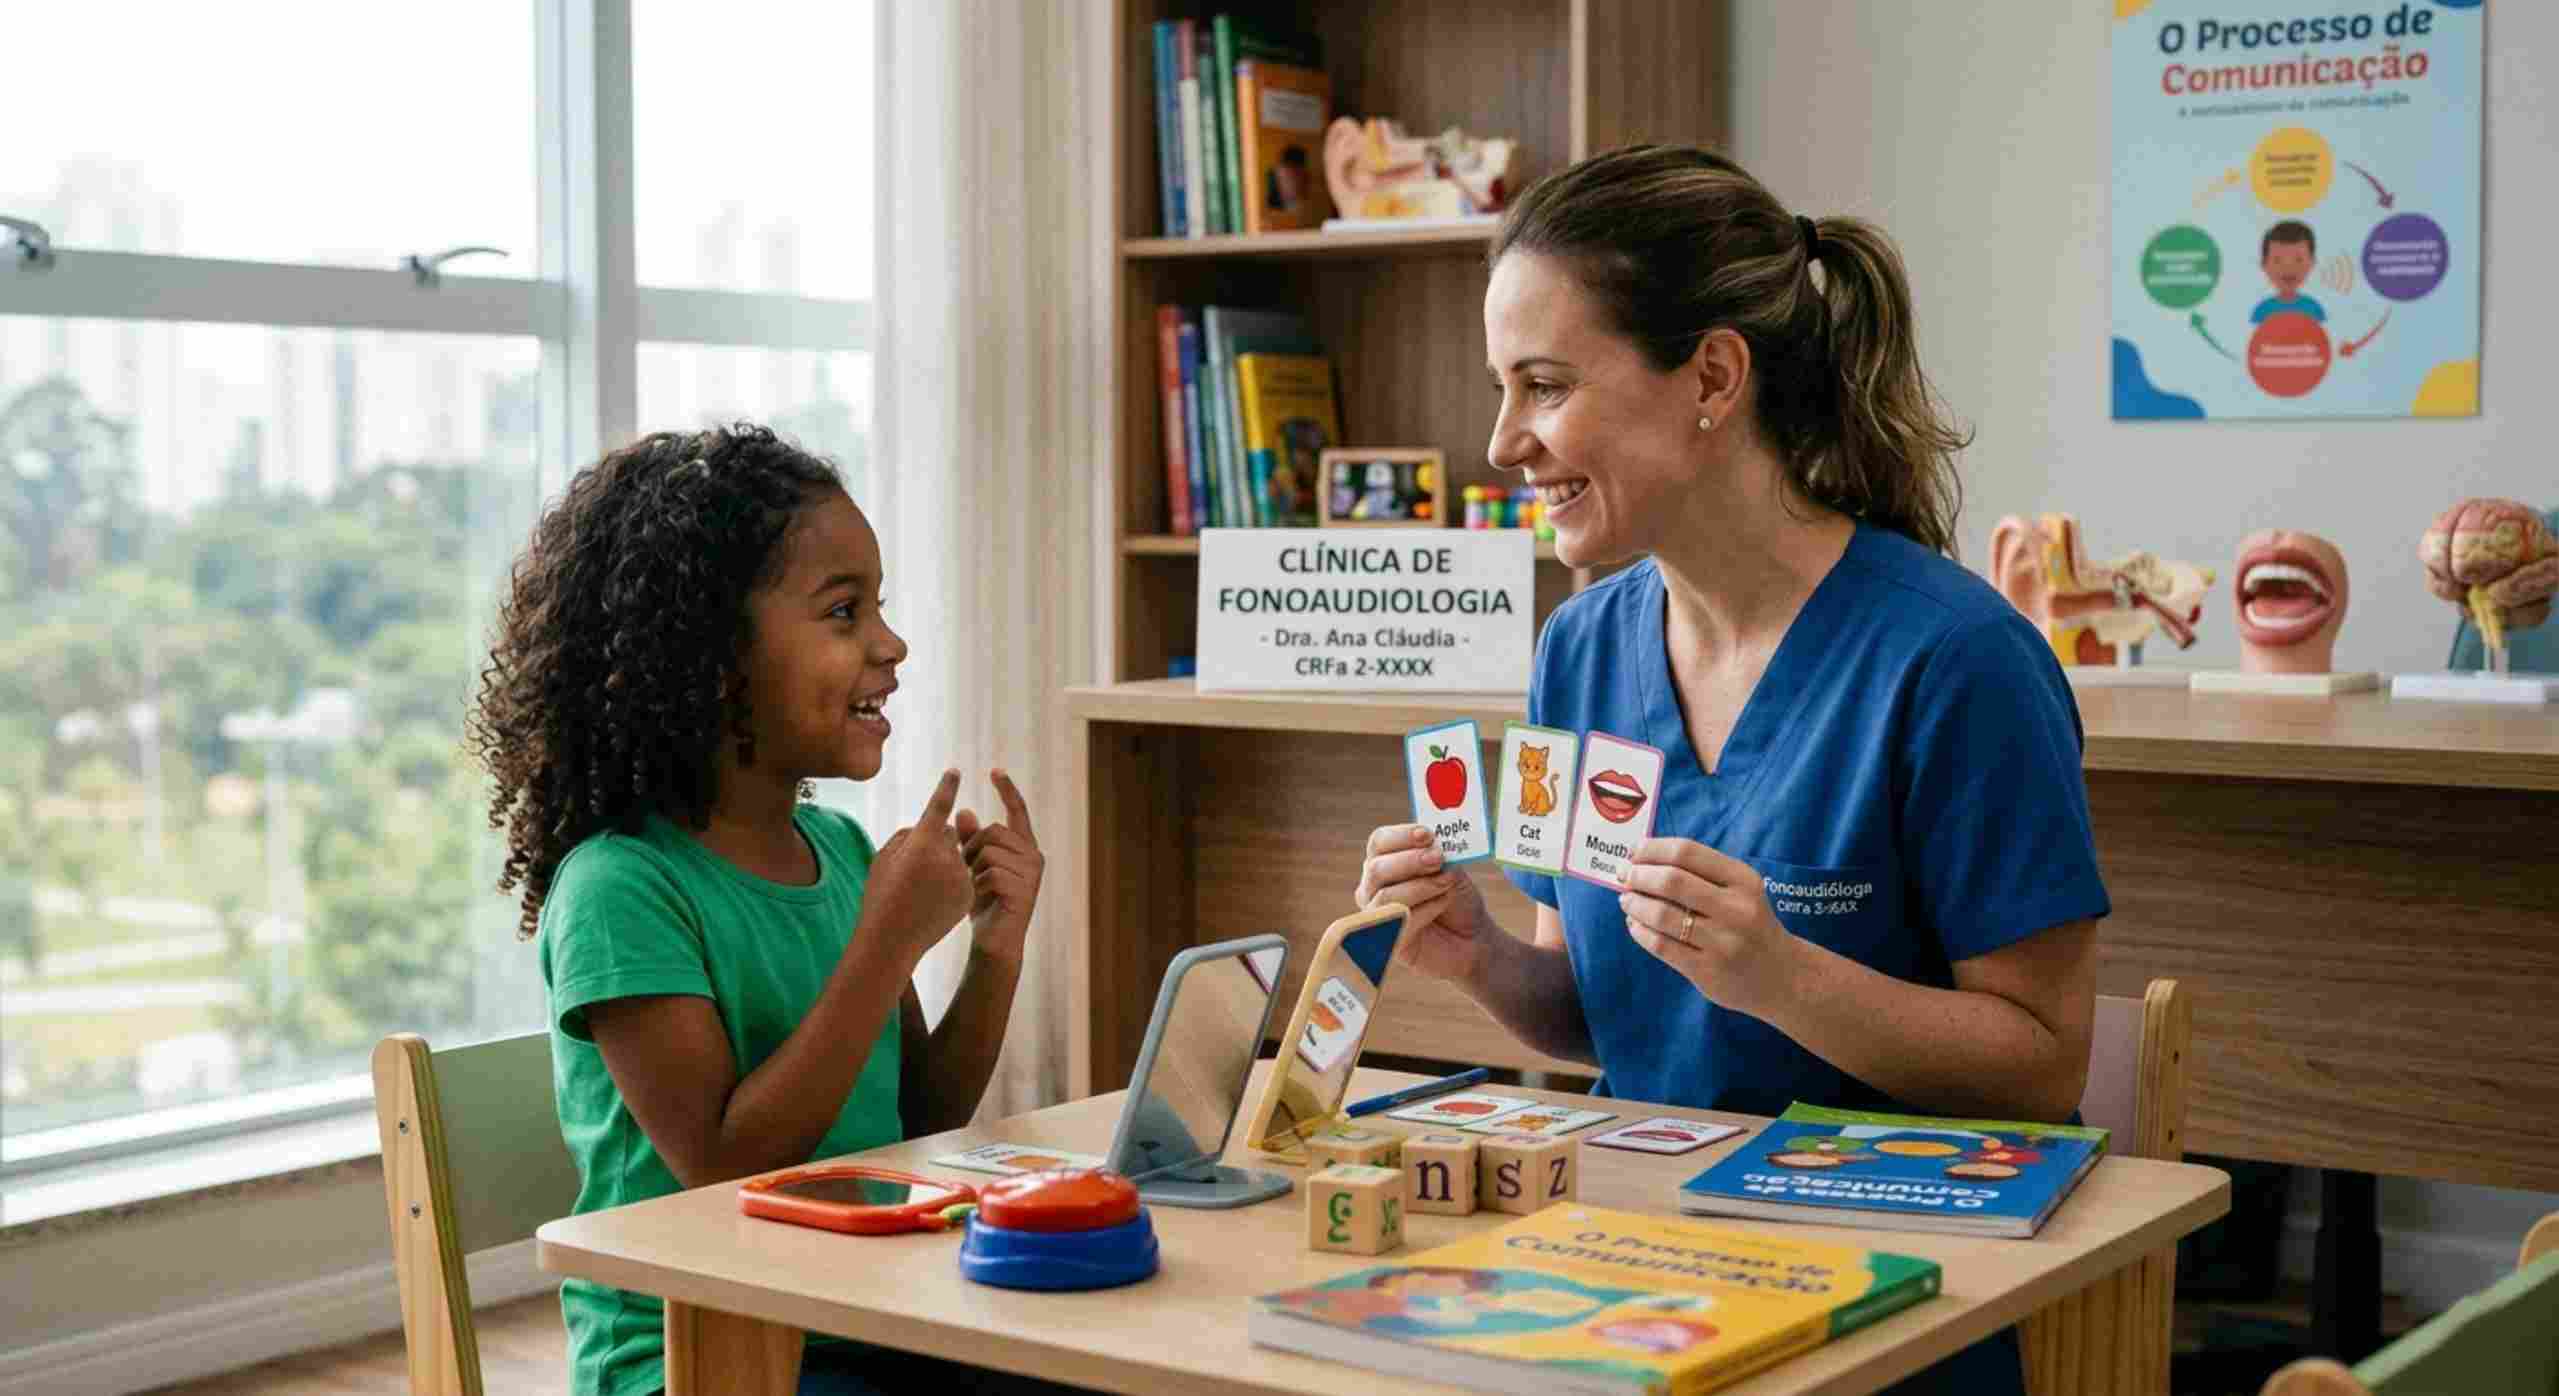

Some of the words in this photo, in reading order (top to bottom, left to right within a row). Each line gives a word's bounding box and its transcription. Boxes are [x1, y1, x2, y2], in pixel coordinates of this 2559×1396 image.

[2159, 22, 2186, 53] O
[2197, 13, 2374, 50] Processo
[2385, 3, 2433, 37] de
[2161, 45, 2430, 95] Comunicação
[1278, 541, 1401, 574] CLÍNICA
[1412, 548, 1453, 574] DE
[1218, 587, 1513, 615] FONOAUDIOLOGIA
[1275, 628, 1319, 648] Dra.
[1325, 628, 1367, 648] Ana
[1374, 628, 1456, 648] Cláudia
[1295, 657, 1348, 677] CRFa
[1354, 658, 1434, 677] 2-XXXX
[1435, 819, 1471, 839] Apple
[1519, 824, 1542, 841] Cat
[1415, 1159, 1454, 1202] n
[1496, 1159, 1523, 1199] s
[1548, 1157, 1568, 1199] z
[1953, 1199, 1984, 1208] O
[1575, 1231, 1606, 1242] O
